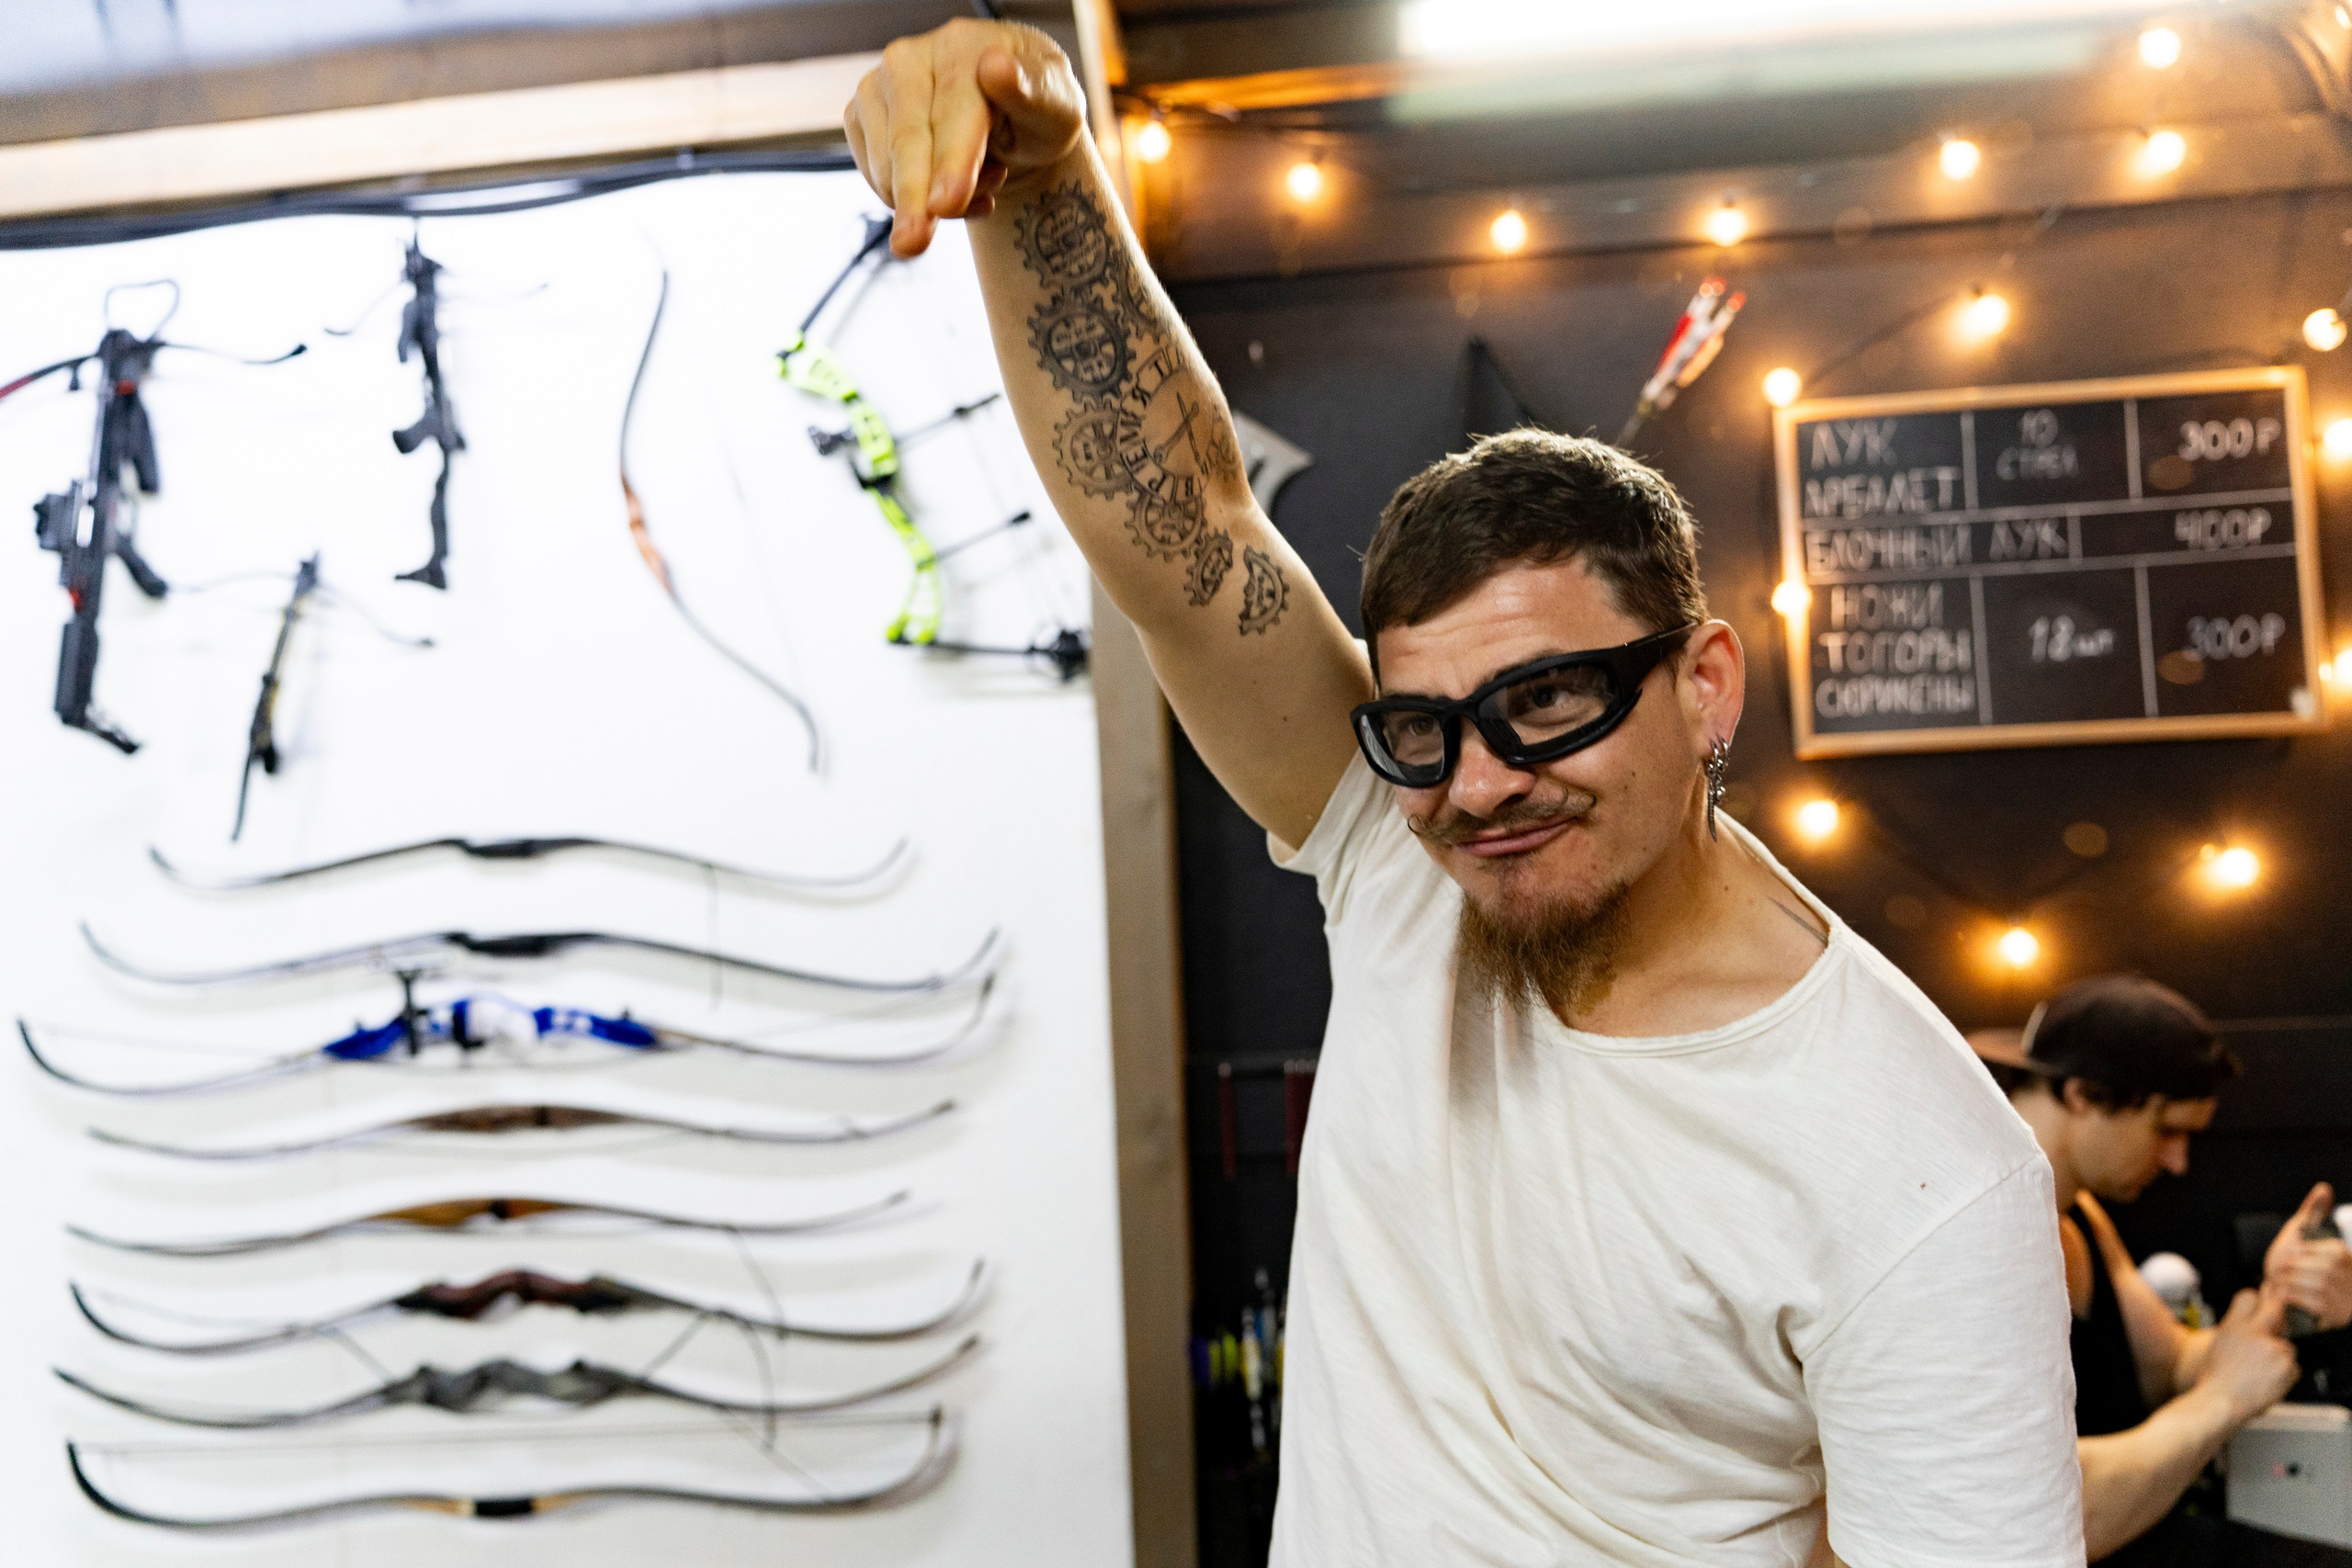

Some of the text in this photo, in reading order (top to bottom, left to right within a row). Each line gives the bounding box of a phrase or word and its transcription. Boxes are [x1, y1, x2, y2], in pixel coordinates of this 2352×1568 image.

[1811, 419, 1898, 469] ЛУК
[1990, 516, 2067, 560] ЛУК
[1830, 581, 1943, 631] НОЖИ
[1818, 626, 1972, 673] ТОПОРЫ
